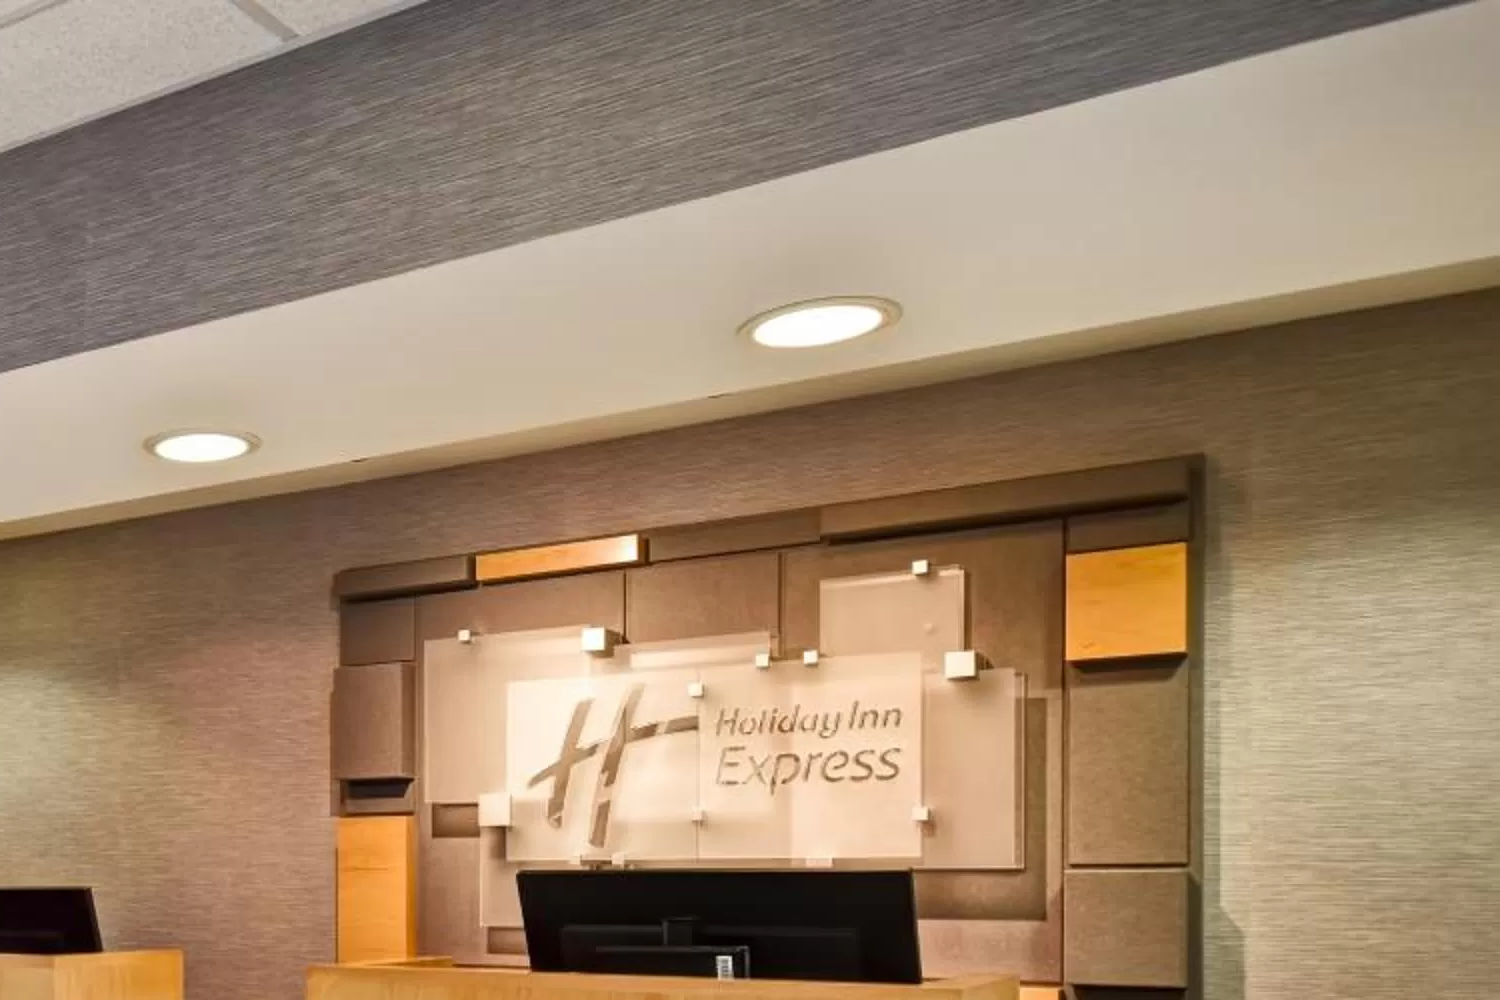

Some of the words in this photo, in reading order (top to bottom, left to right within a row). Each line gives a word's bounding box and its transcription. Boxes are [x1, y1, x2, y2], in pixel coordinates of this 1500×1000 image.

[715, 703, 841, 739] Holiday
[849, 700, 902, 731] Inn
[715, 746, 903, 796] Express
